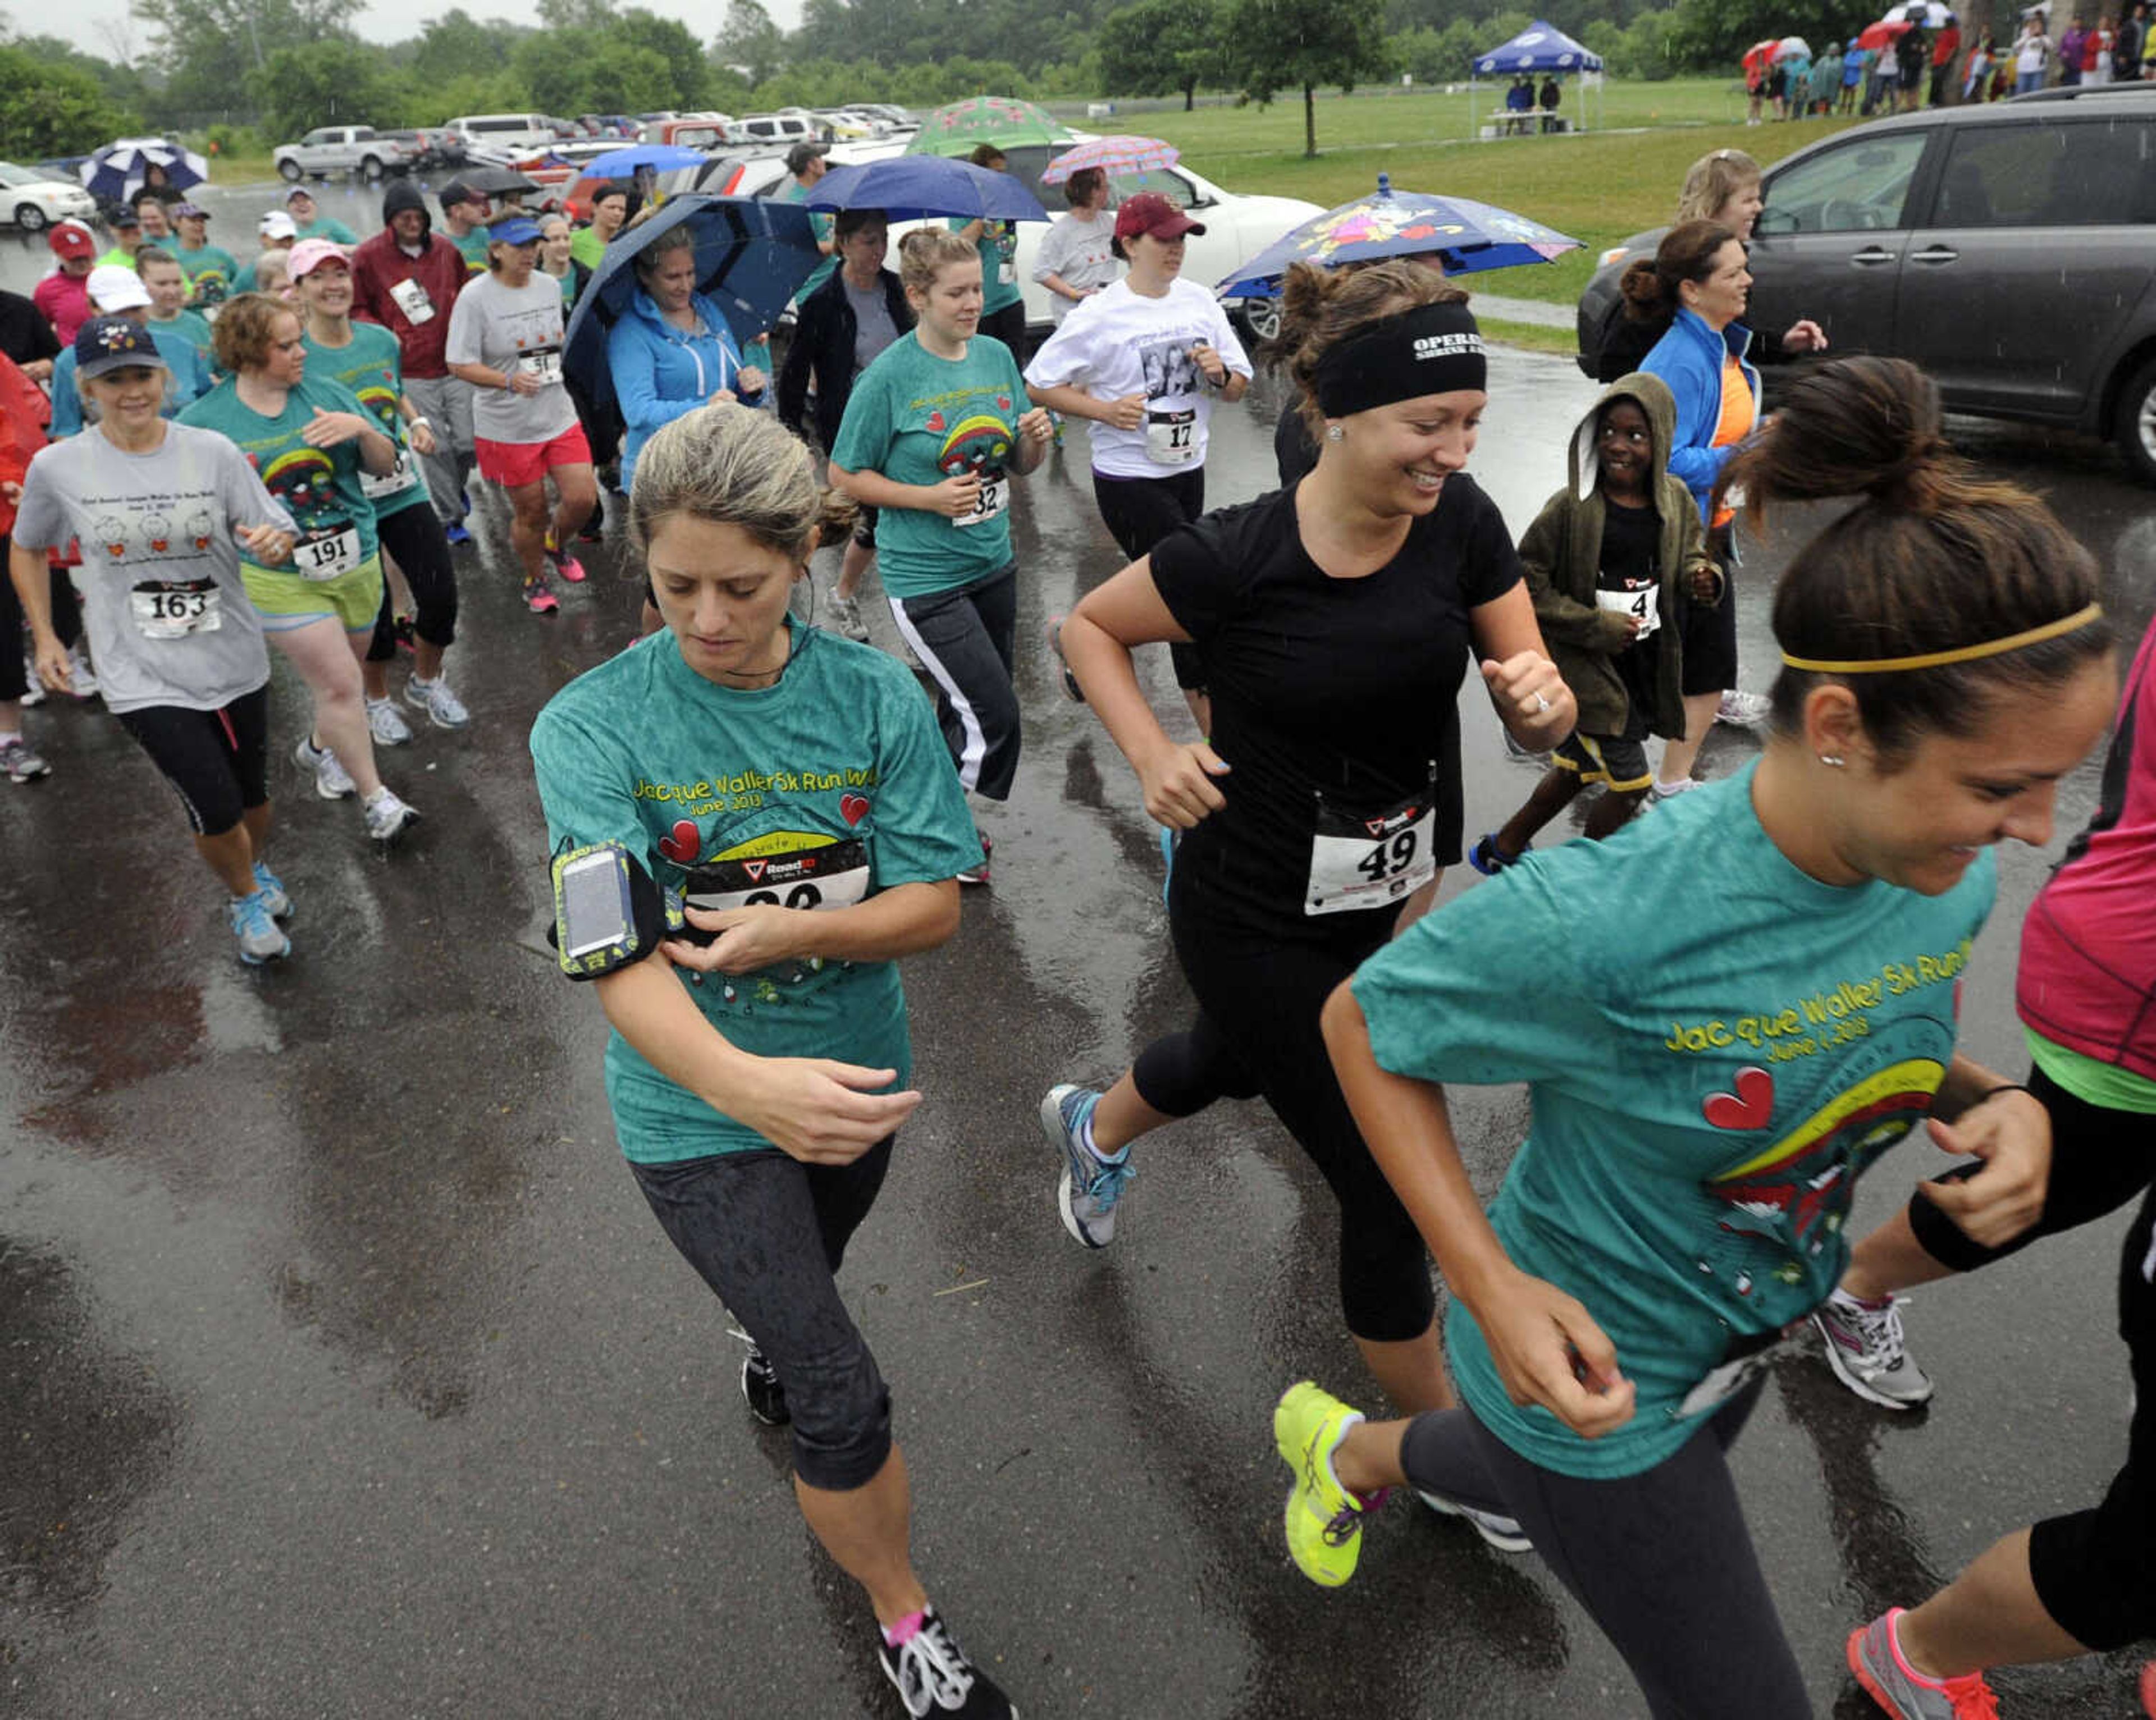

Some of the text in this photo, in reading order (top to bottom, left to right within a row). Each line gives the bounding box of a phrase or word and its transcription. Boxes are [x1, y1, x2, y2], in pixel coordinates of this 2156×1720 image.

[1170, 425, 1191, 447] 17
[311, 537, 348, 568] 191
[152, 593, 206, 619] 163
[1631, 593, 1647, 617] 4
[634, 779, 711, 805] Jacque
[802, 771, 842, 792] Run
[846, 767, 874, 788] W
[690, 799, 724, 816] June
[1358, 830, 1417, 882] 49
[1799, 977, 1883, 1025] Waller
[1917, 952, 1963, 986] Run
